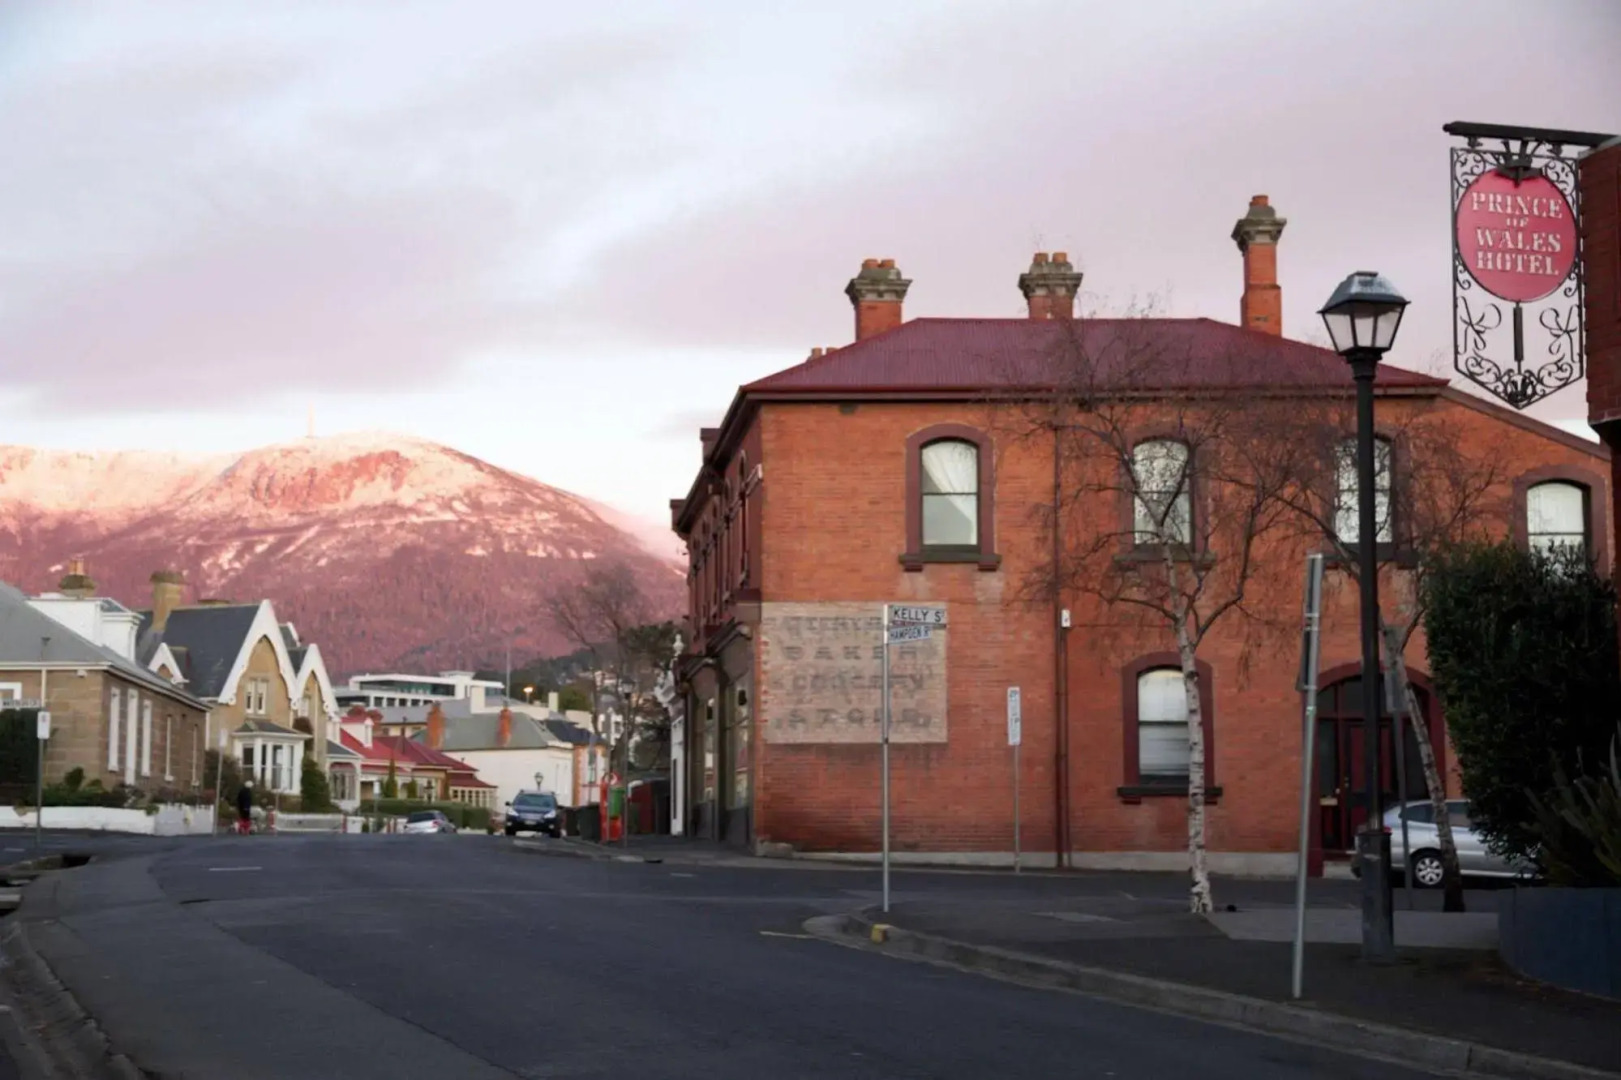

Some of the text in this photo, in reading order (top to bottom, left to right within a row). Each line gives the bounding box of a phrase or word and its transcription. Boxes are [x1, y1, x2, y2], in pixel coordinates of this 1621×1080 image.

[1472, 192, 1562, 218] PRINCE
[1506, 217, 1529, 227] OF
[1476, 228, 1561, 252] WALES
[1476, 251, 1559, 275] HOTEL
[894, 608, 929, 621] KELLY
